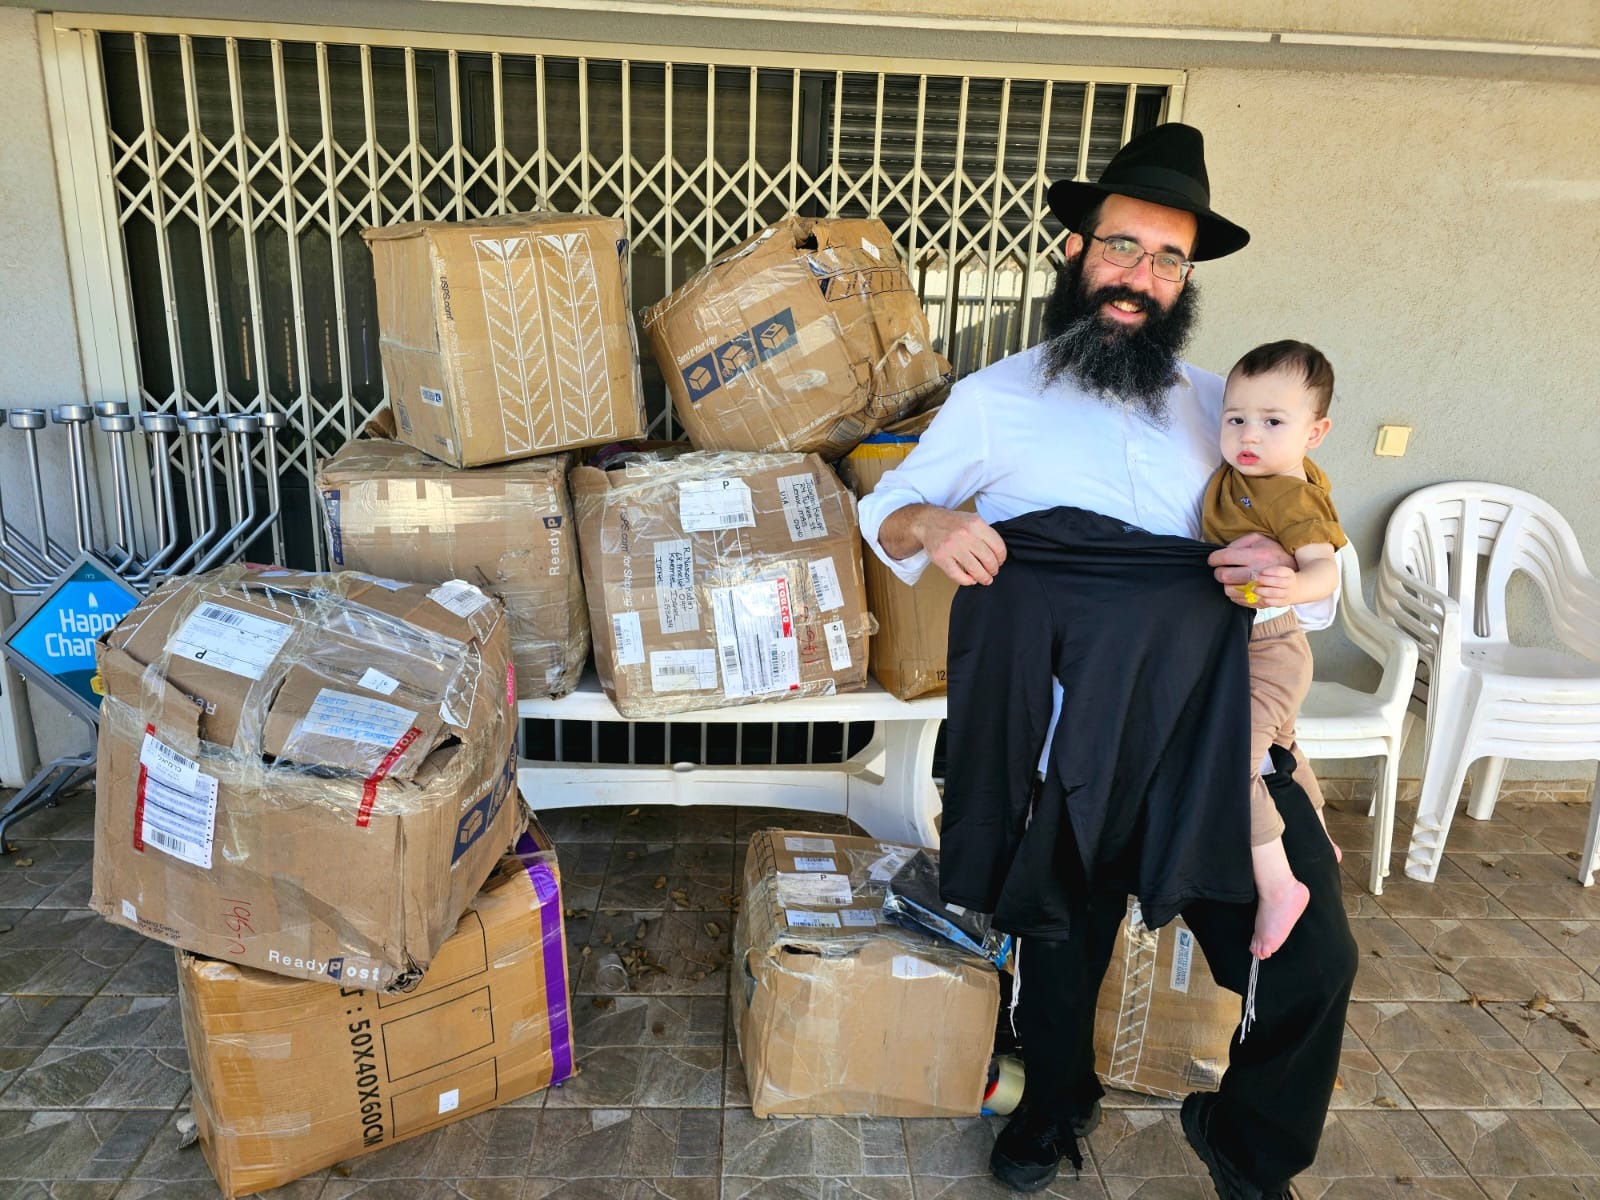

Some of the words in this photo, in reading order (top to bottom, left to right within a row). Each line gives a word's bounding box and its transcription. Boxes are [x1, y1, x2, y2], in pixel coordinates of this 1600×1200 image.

[723, 480, 730, 489] P
[59, 608, 126, 636] Happy
[45, 633, 98, 657] Chan
[195, 650, 207, 660] P
[936, 671, 946, 680] 12
[268, 949, 380, 981] ReadyPost
[348, 1019, 385, 1148] 50X40X60CM
